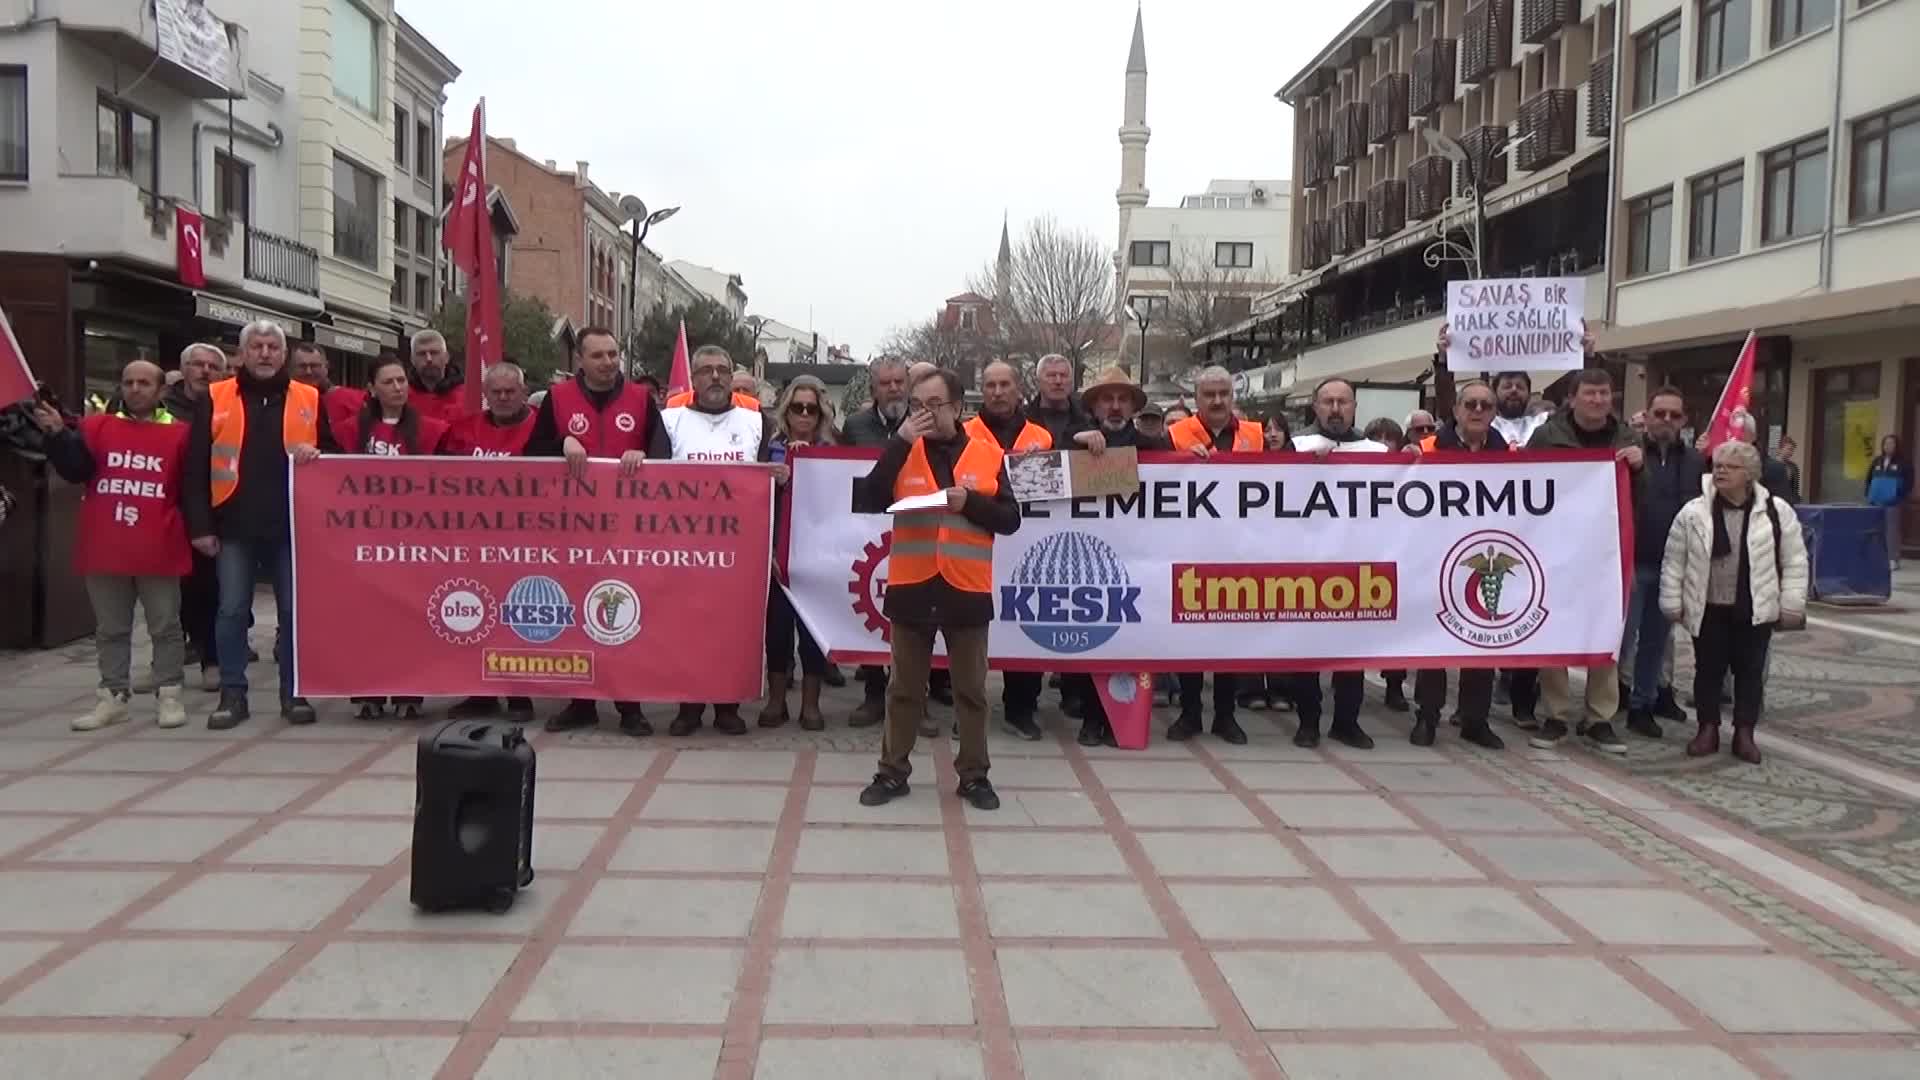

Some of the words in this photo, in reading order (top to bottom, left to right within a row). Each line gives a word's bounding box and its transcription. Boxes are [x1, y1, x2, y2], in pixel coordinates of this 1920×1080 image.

[1459, 283, 1531, 309] SAVAŞ
[1544, 284, 1568, 305] BİR
[1454, 312, 1499, 331] HALK
[1505, 307, 1567, 330] SAĞLIĞI
[1468, 331, 1577, 360] SORUNUDUR
[367, 436, 401, 456] İSK
[107, 450, 164, 472] DİSK
[97, 478, 166, 498] GENEL
[338, 472, 598, 498] ABD-İSRAİL'İN
[1071, 480, 1220, 519] EMEK
[1238, 479, 1555, 519] PLATFORMU
[115, 502, 139, 526] İŞ
[326, 504, 618, 532] MÜDAHALESİNE
[635, 512, 742, 536] HAYIR
[355, 541, 470, 563] EDİRNE
[480, 545, 560, 565] EMEK
[568, 547, 736, 569] PLATFORMU
[1178, 564, 1393, 611] tmmob
[444, 601, 482, 618] DİSK
[502, 604, 575, 625] KESK
[1001, 585, 1141, 623] KESK
[1178, 611, 1205, 621] TÜRK
[1208, 610, 1260, 621] MÜHENDİS
[1263, 611, 1276, 620] VE
[1278, 610, 1311, 620] MİMAR
[1313, 611, 1354, 619] ODALARI
[1357, 609, 1393, 619] BİRLİĞİ
[1050, 630, 1090, 648] 1995
[1444, 611, 1465, 634] TÜRK
[1467, 630, 1514, 643] TABİPLERİ
[486, 652, 590, 674] tmmob
